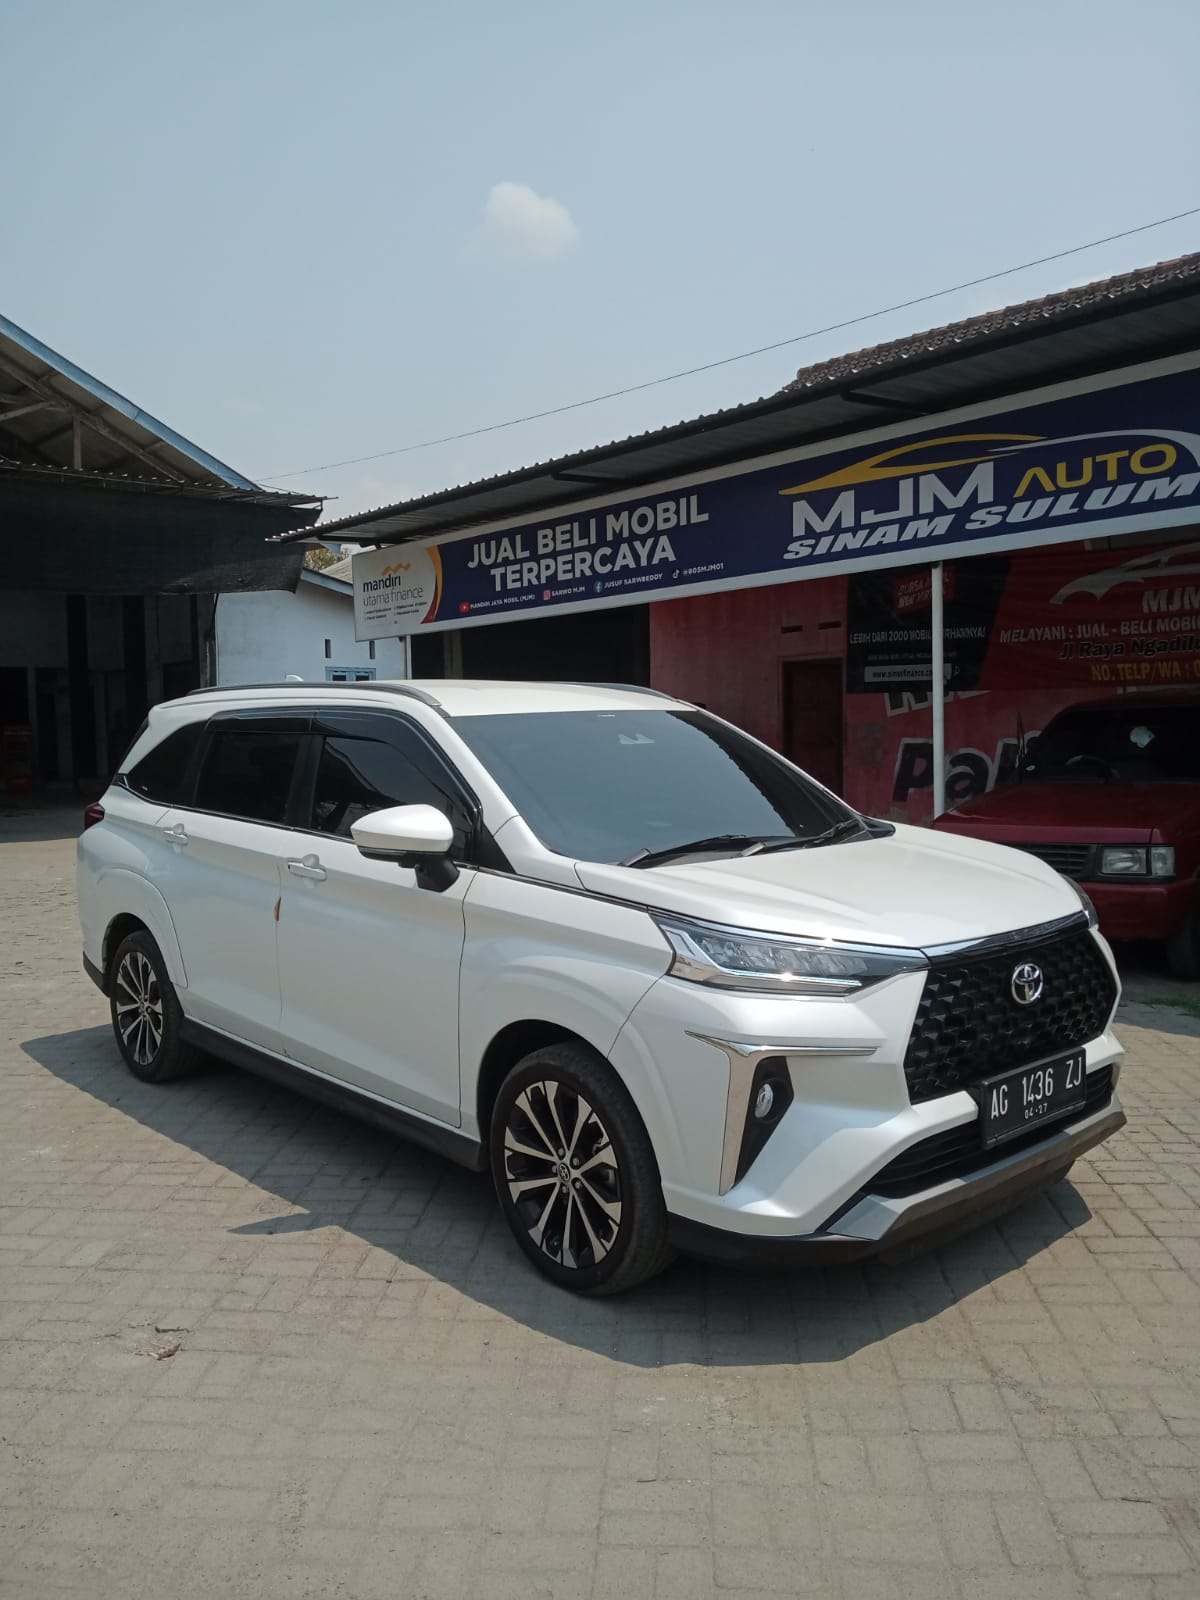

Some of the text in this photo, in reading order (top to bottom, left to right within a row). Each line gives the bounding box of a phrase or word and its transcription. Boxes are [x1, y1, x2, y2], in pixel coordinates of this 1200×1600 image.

[792, 443, 1177, 537] MJM AUTO
[782, 471, 1200, 560] SINAM SULUM
[467, 494, 709, 569] JUAL BELI MOBIL
[490, 534, 677, 592] TERPERCAYA
[363, 573, 401, 593] mandiri
[363, 592, 390, 607] utama
[390, 586, 424, 603] finance
[573, 586, 586, 594] MJM
[604, 580, 623, 589] JUSUF
[888, 630, 909, 642] 2000
[999, 626, 1066, 644] MELAYANI
[1076, 622, 1109, 639] JUAL
[1120, 619, 1153, 636] BELI
[1156, 615, 1200, 633] MOBI
[990, 1056, 1082, 1120] AG 1436 ZJ
